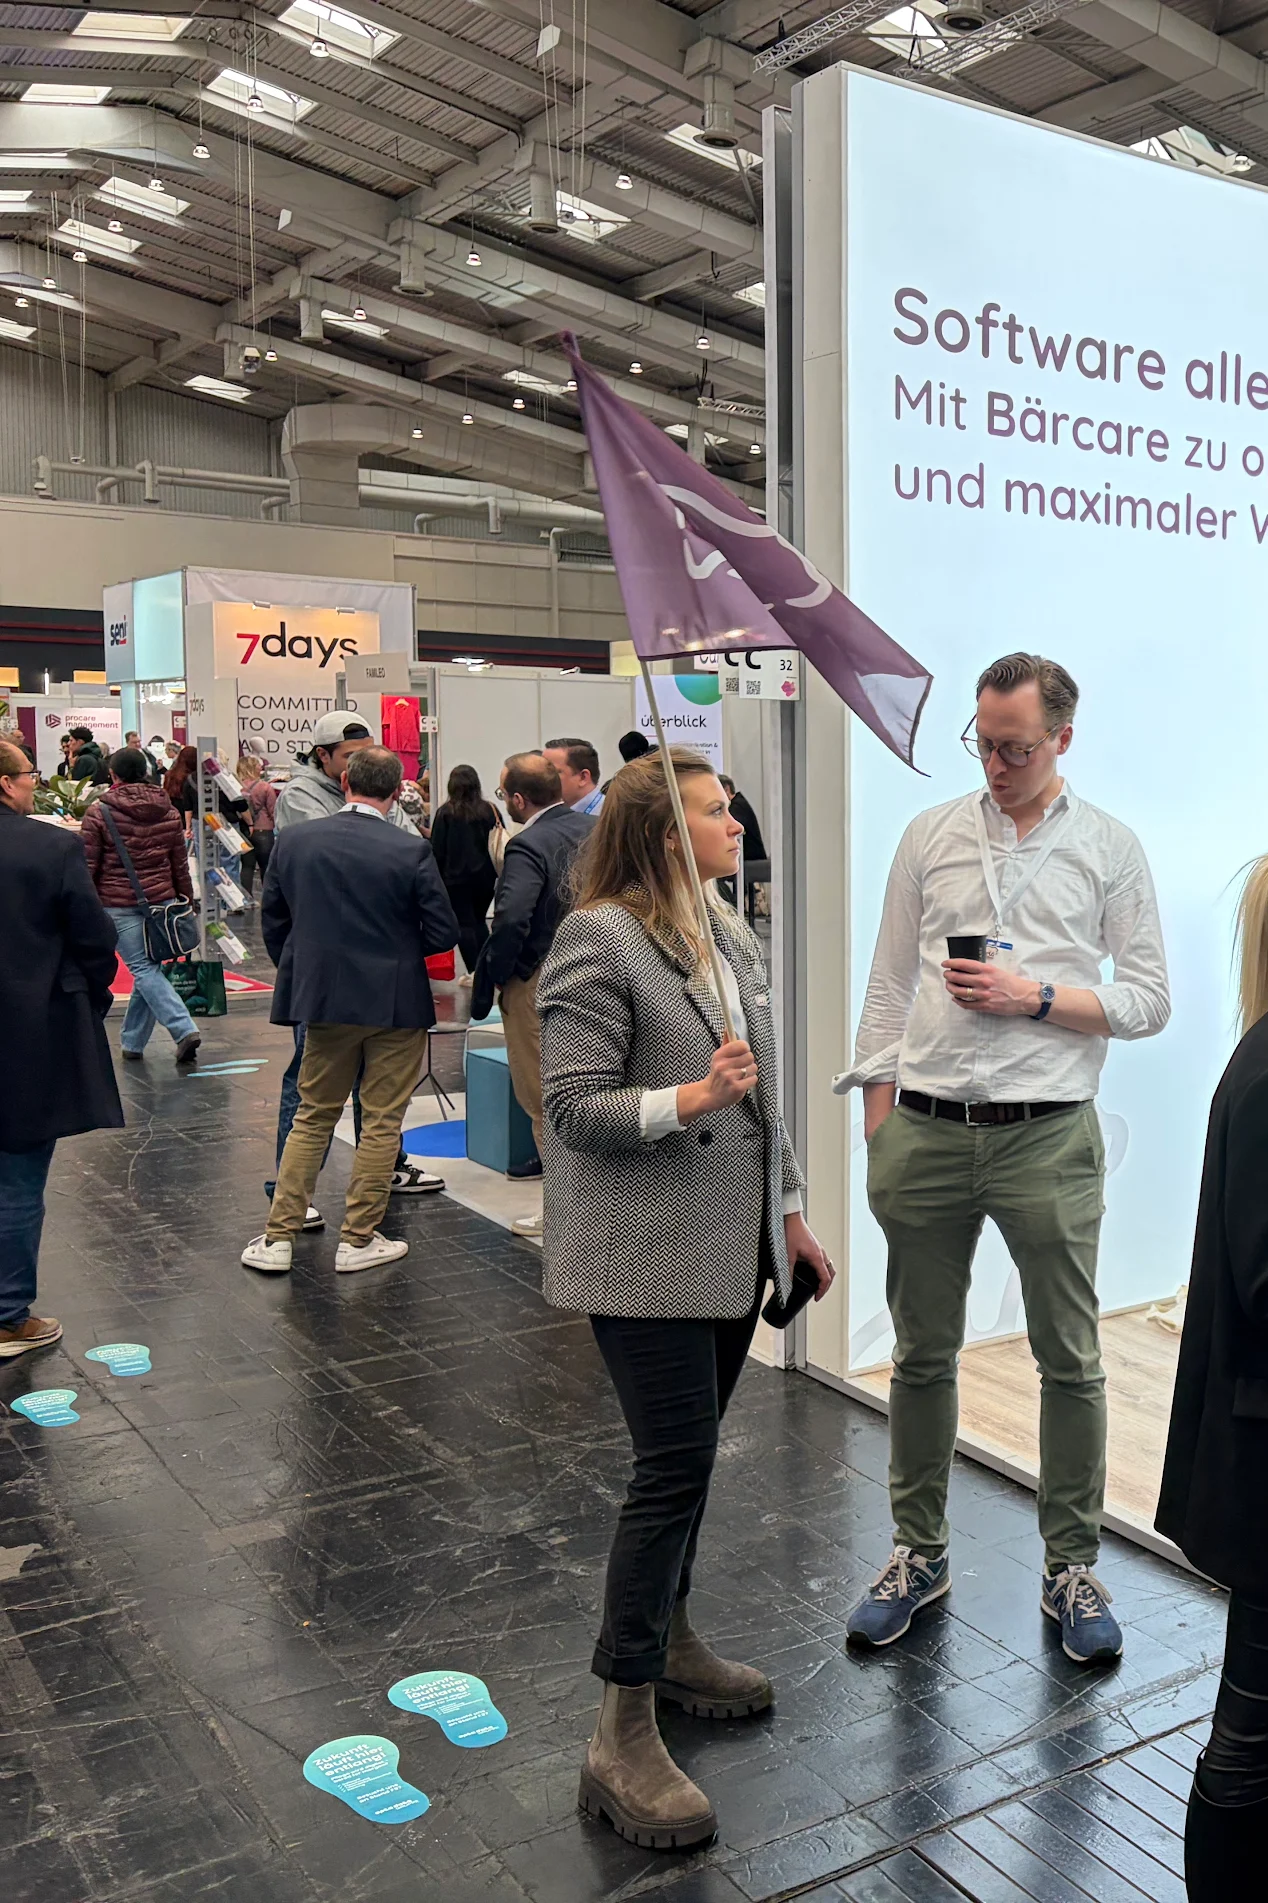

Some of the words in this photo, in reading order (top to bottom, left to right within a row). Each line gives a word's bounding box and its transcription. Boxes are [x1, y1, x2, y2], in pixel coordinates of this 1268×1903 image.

[894, 287, 1166, 391] Software
[895, 375, 967, 431] Mit
[987, 391, 1170, 463] Bärcare
[1184, 436, 1227, 471] zu
[894, 462, 985, 508] und
[1005, 483, 1237, 539] maximaler
[237, 621, 359, 668] 7days
[780, 659, 793, 671] 32
[238, 717, 265, 732] TO
[271, 718, 318, 734] QUA
[241, 739, 281, 753] AD
[402, 1675, 455, 1695] Zukunft
[313, 1743, 370, 1766] Zukunft
[319, 1756, 354, 1771] läuft
[356, 1746, 383, 1759] hier
